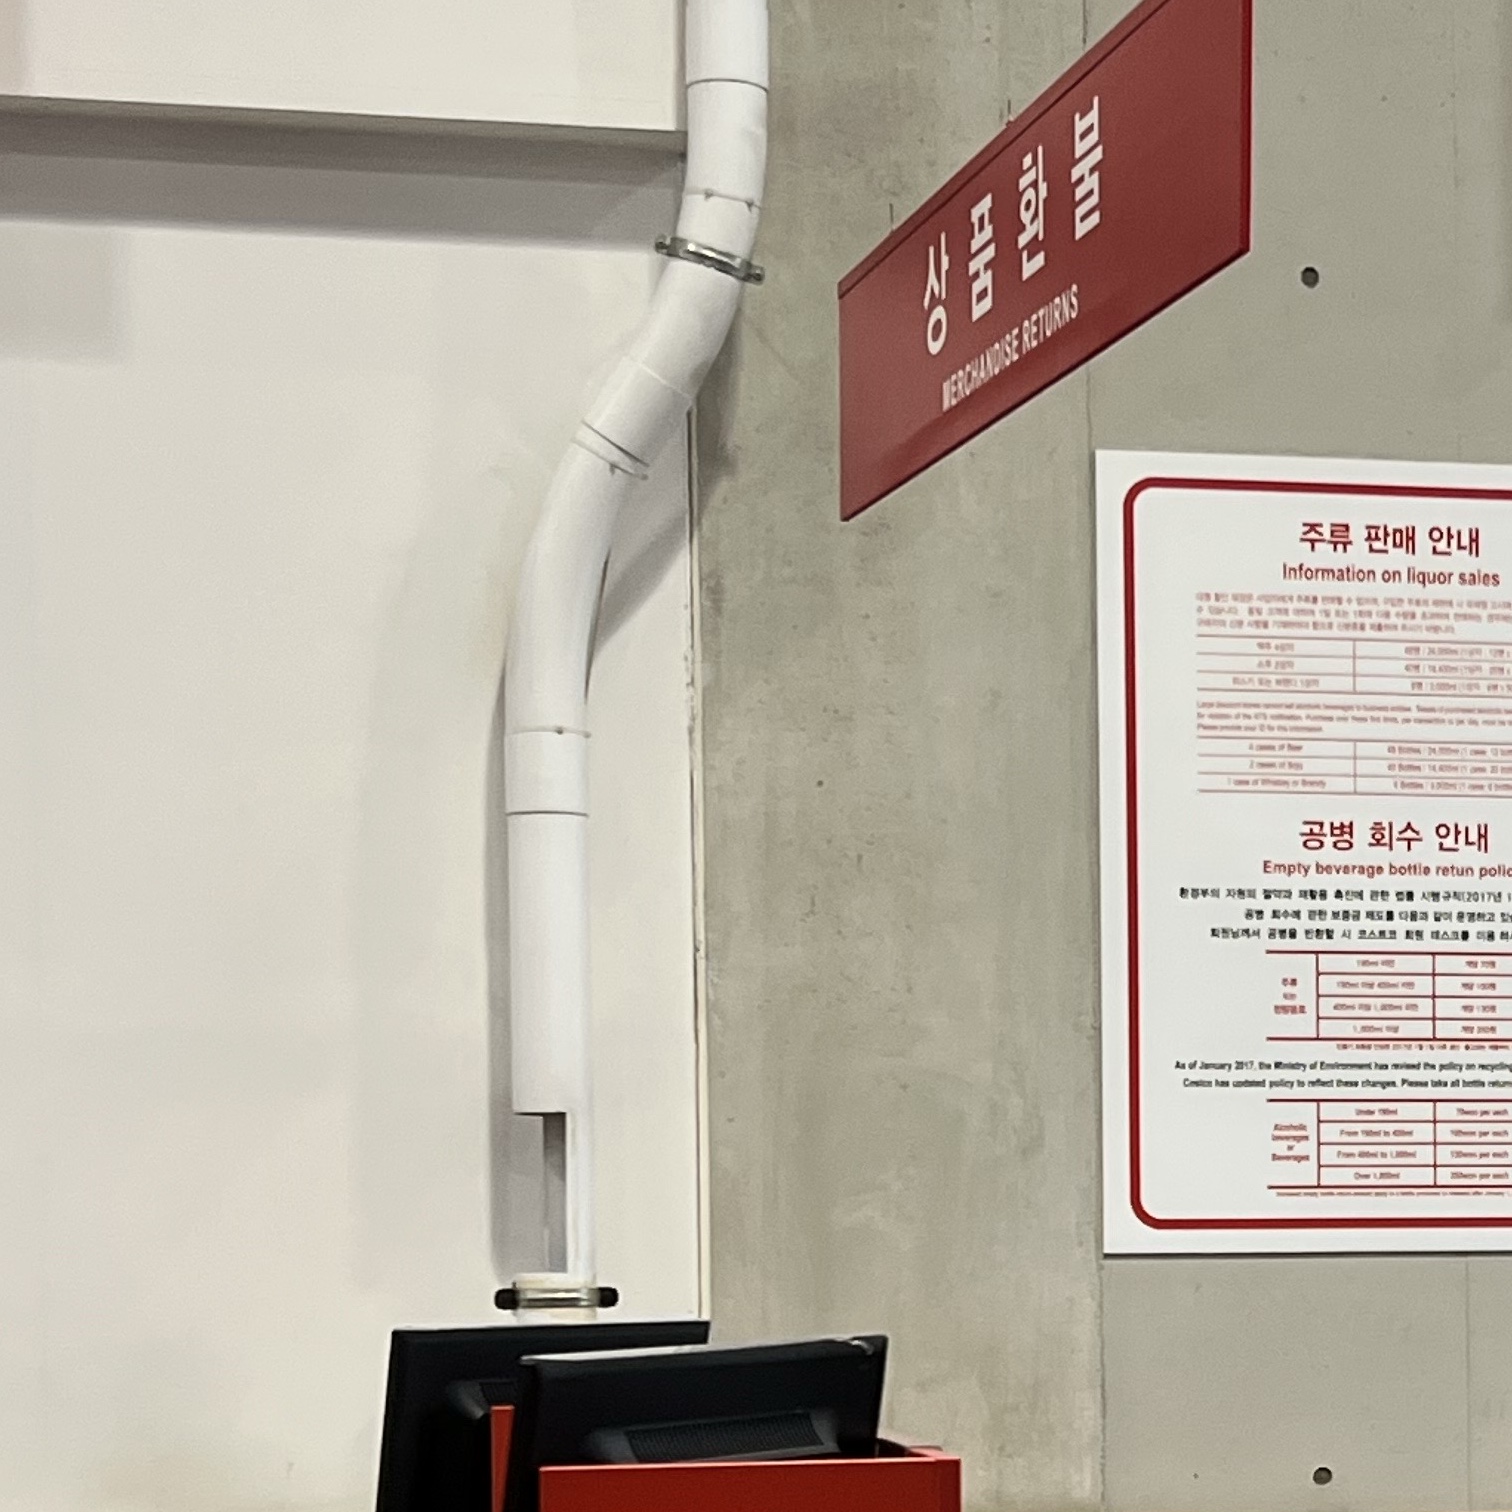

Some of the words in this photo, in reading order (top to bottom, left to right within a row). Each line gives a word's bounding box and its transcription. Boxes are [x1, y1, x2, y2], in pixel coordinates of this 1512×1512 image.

[943, 329, 1019, 412] MERCHANDISE
[1022, 284, 1079, 354] RETURNS
[1300, 523, 1352, 553] 주류
[1365, 524, 1415, 555] 판매
[1428, 526, 1479, 557] 안내
[1283, 563, 1376, 582] Information
[1381, 570, 1402, 583] on
[1407, 567, 1454, 588] liquor
[1458, 569, 1500, 587] sales
[1300, 821, 1353, 851] 공병
[1368, 822, 1422, 852] 회수
[1436, 823, 1488, 853] 안내
[1263, 860, 1311, 877] Empty
[1315, 861, 1384, 879] beverage
[1388, 862, 1431, 876] bottle
[1435, 865, 1474, 877] retun
